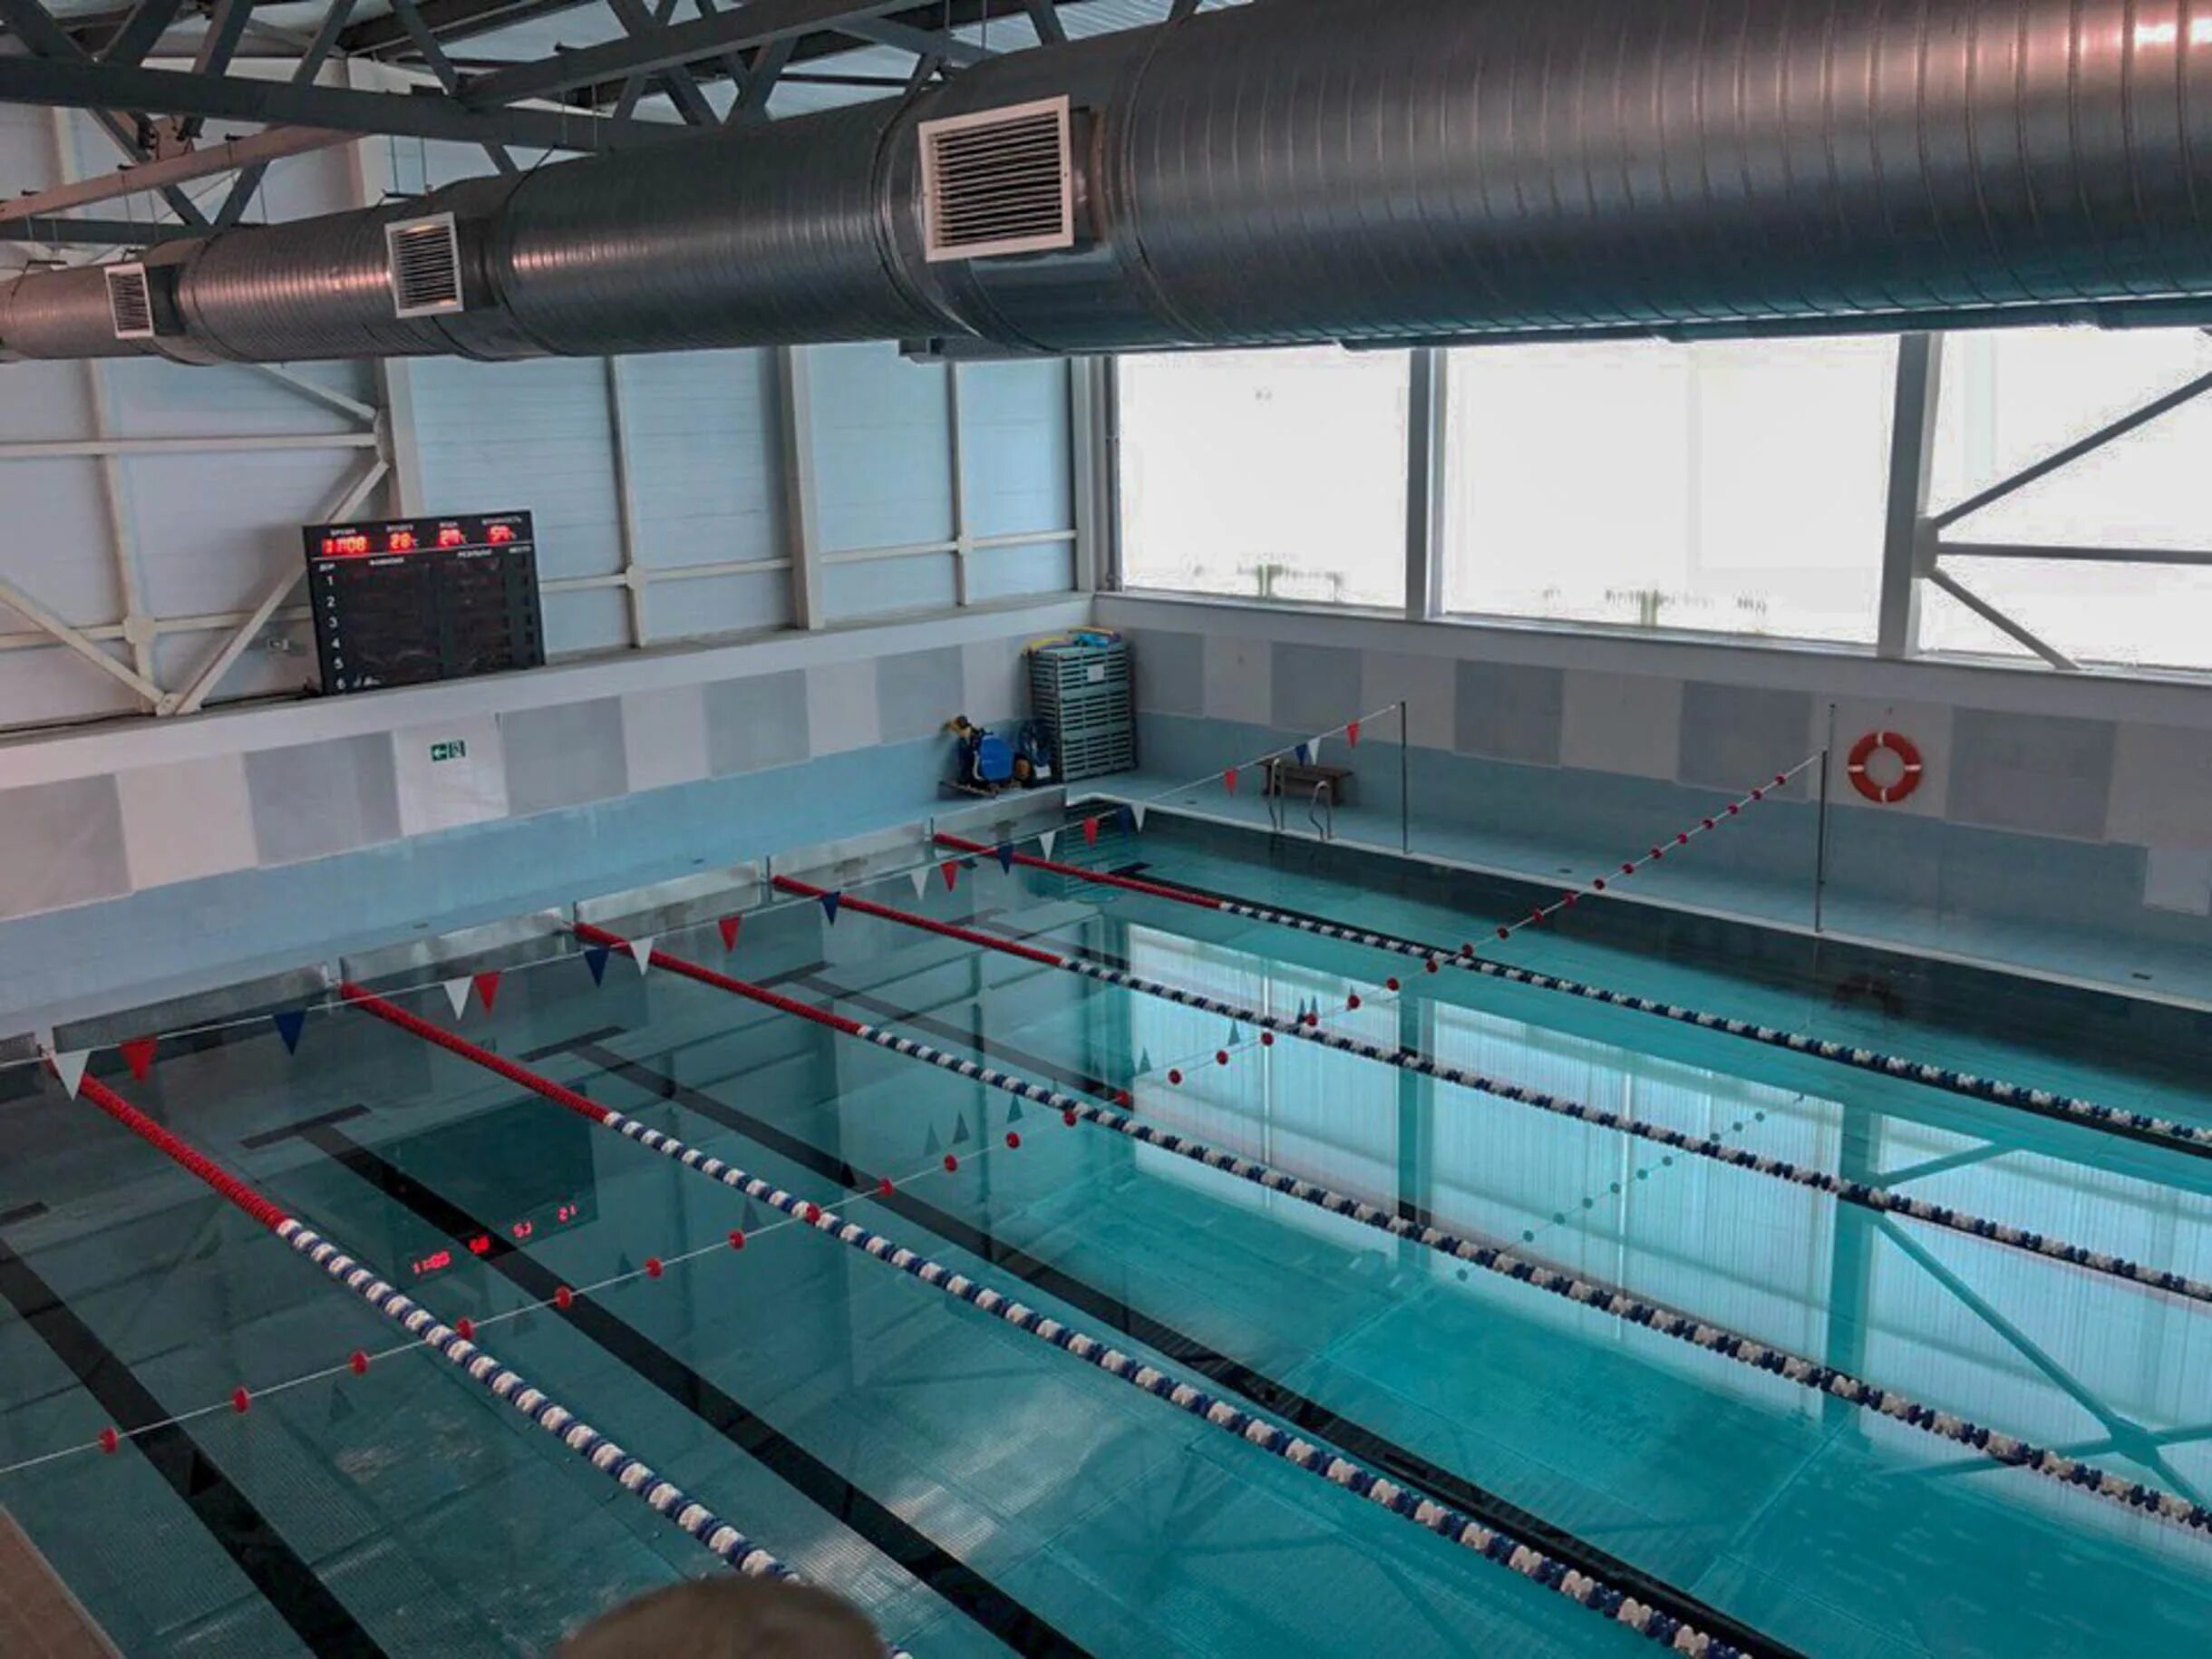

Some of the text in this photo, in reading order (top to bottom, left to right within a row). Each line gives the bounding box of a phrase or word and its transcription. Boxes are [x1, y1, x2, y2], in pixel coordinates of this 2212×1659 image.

[326, 596, 335, 607] 2
[328, 616, 338, 628] 3
[331, 637, 340, 648] 4
